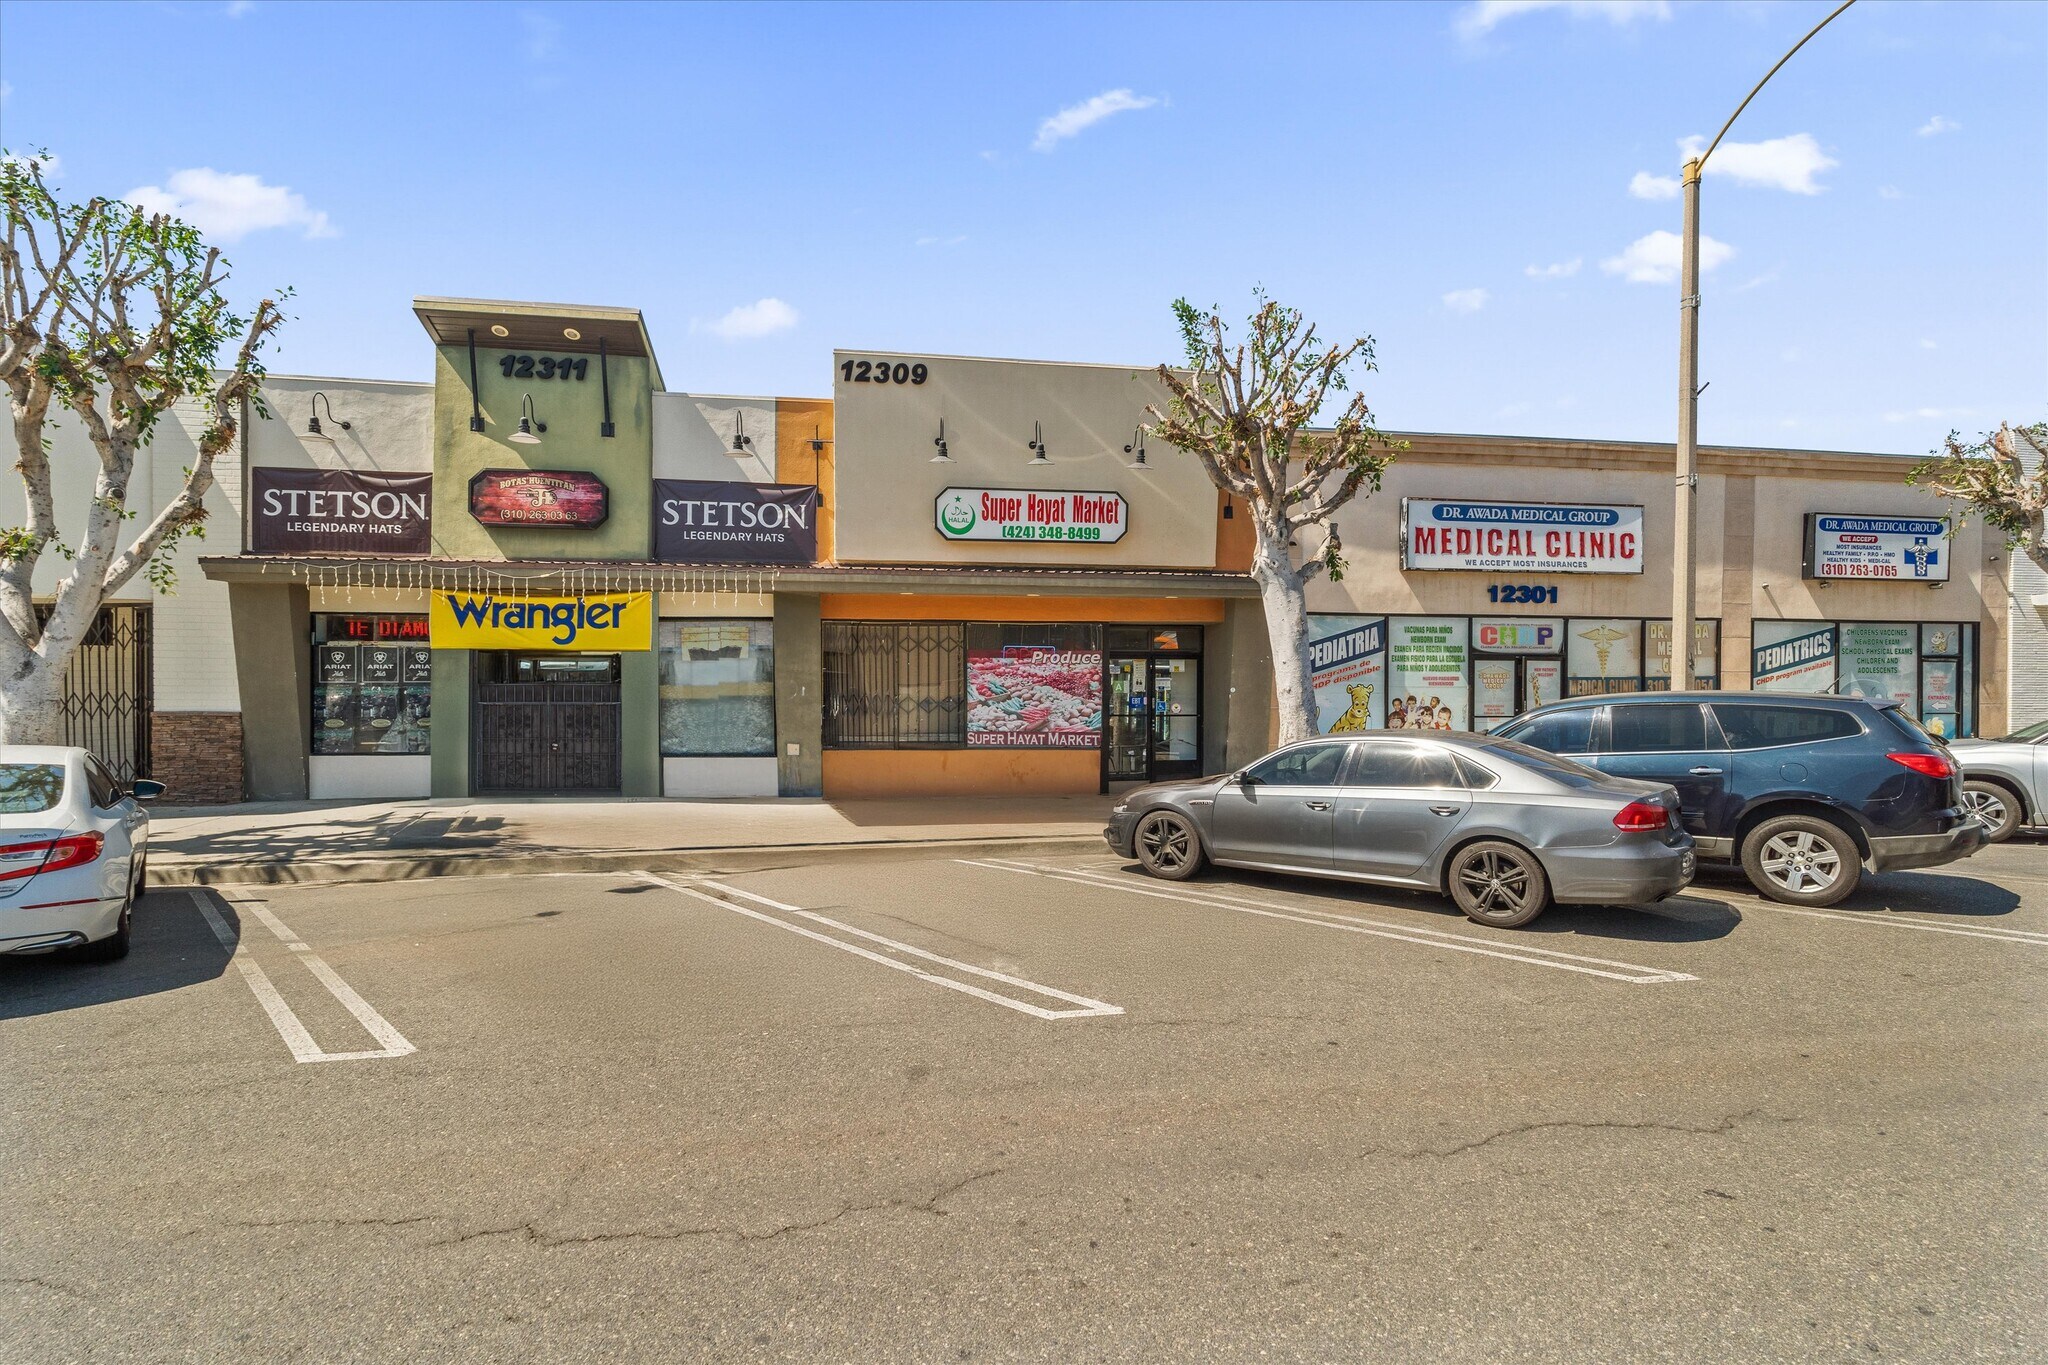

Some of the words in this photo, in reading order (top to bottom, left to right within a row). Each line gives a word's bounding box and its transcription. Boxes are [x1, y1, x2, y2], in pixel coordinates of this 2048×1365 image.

[499, 354, 588, 381] 12311
[841, 360, 928, 385] 12309
[500, 477, 527, 489] BOTAS
[263, 489, 427, 520] STETSON
[981, 492, 1022, 524] Super
[1028, 494, 1066, 525] Hayat
[1073, 494, 1120, 524] Market
[500, 510, 526, 520] (310)
[529, 510, 548, 519] 263
[550, 510, 562, 520] 03
[566, 511, 578, 520] 63
[662, 499, 807, 530] STETSON
[1442, 506, 1464, 518] DR.
[1466, 508, 1508, 520] AWADA
[1511, 510, 1566, 521] MEDICAL
[1568, 510, 1610, 523] GROUP
[287, 522, 365, 534] LEGENDARY
[369, 524, 402, 534] HATS
[1002, 526, 1036, 538] (424)
[1038, 526, 1100, 540] 348-8499
[1826, 520, 1840, 530] DR.
[1841, 521, 1870, 530] AWADA
[1870, 522, 1908, 532] MEDICAL
[1909, 522, 1938, 532] GROUP
[684, 530, 751, 542] LEGENDARY
[756, 533, 785, 543] HATS
[1414, 527, 1536, 557] MEDICAL
[1546, 530, 1636, 560] CLINIC
[1538, 560, 1588, 568] INSURANCES
[1822, 564, 1847, 576] (310)
[1850, 564, 1898, 576] 263-0765
[1488, 585, 1558, 604] 12301
[447, 594, 627, 645] Wrangler
[1404, 626, 1425, 634] VACUNAS
[1439, 625, 1453, 634] NIÑOS
[1650, 624, 1668, 639] DR.
[1309, 626, 1380, 668] PEDIATRIA
[1757, 632, 1831, 672] PEDIATRICS
[1032, 651, 1100, 664] Produce
[1312, 664, 1356, 682] programa
[1334, 665, 1381, 684] disponible
[1756, 676, 1775, 685] CHDP
[1776, 669, 1802, 681] program
[1804, 661, 1832, 672] available
[1570, 680, 1606, 695] MEDICAL
[1609, 680, 1638, 693] CLINIC
[967, 732, 1004, 745] SUPER
[1008, 732, 1046, 745] HAYAT
[1048, 732, 1100, 746] MARKET
